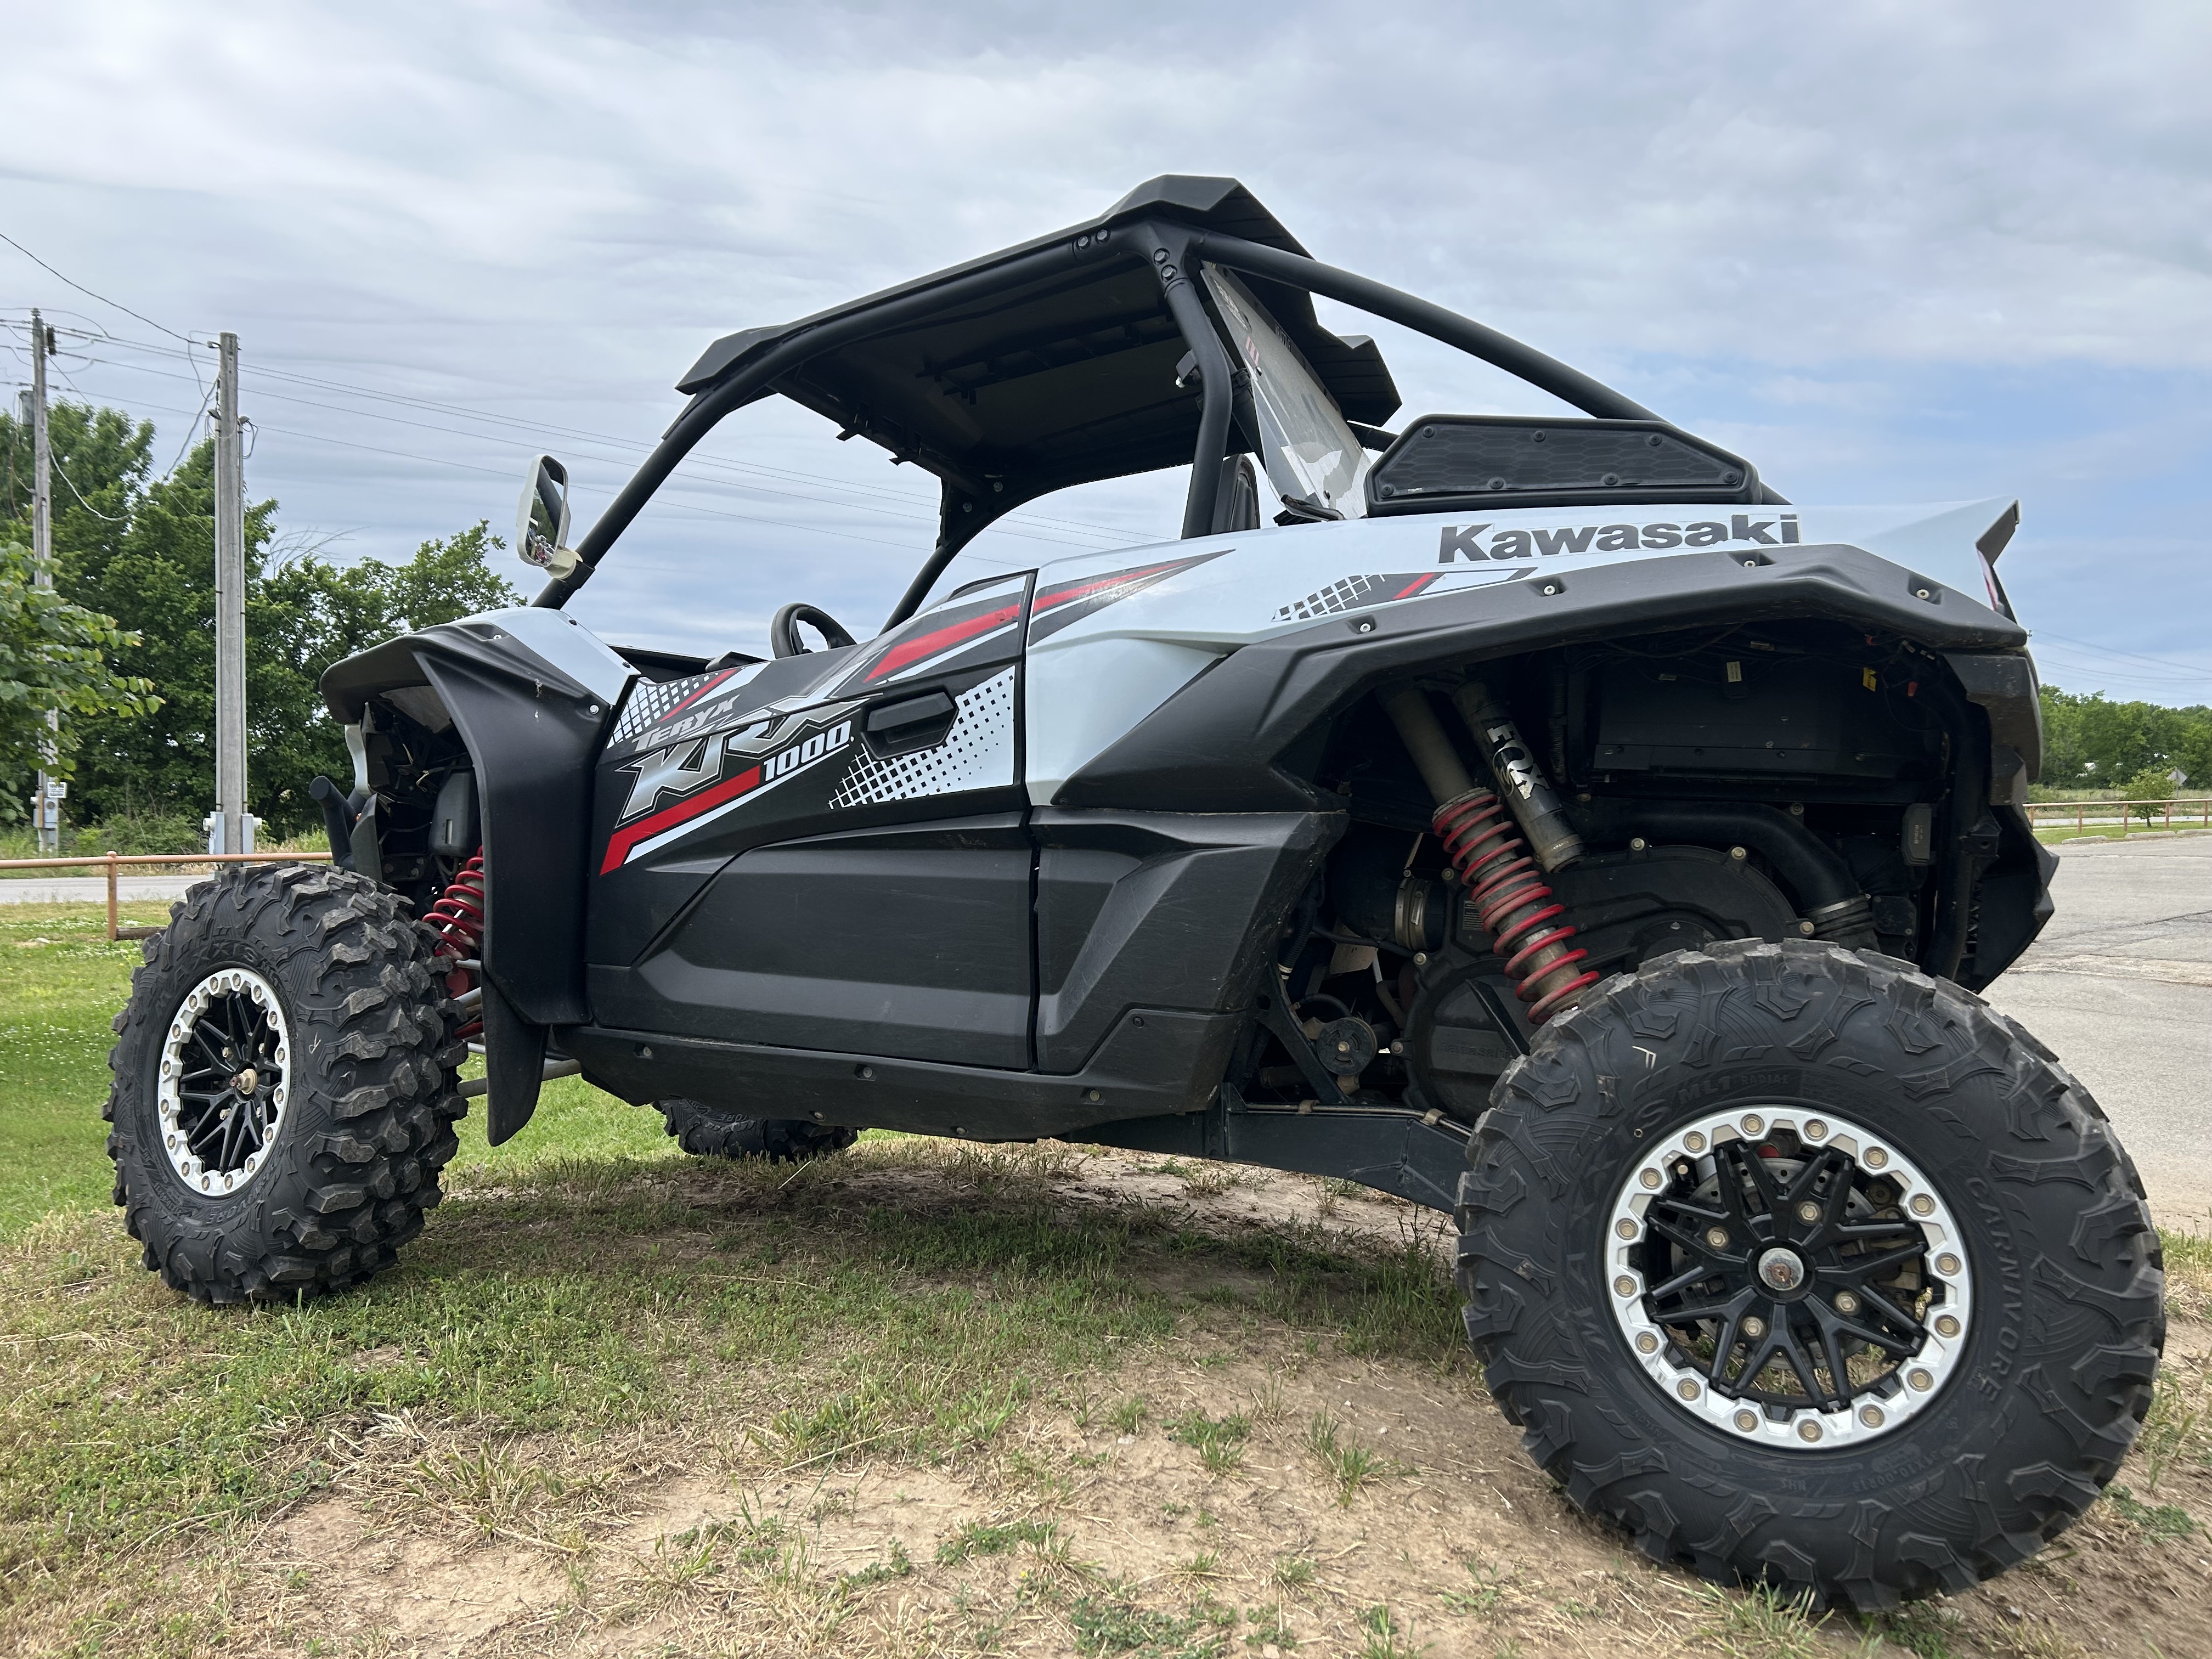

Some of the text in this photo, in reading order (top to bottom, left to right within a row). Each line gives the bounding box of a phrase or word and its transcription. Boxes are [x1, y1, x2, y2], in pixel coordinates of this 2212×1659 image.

[1438, 514, 1800, 564] Kawasaki
[632, 694, 741, 752] TERYX
[763, 720, 852, 782] 1000
[1486, 720, 1551, 800] FOX
[1678, 1075, 1733, 1104] ML1
[1966, 1176, 2023, 1403] CARNIVORE
